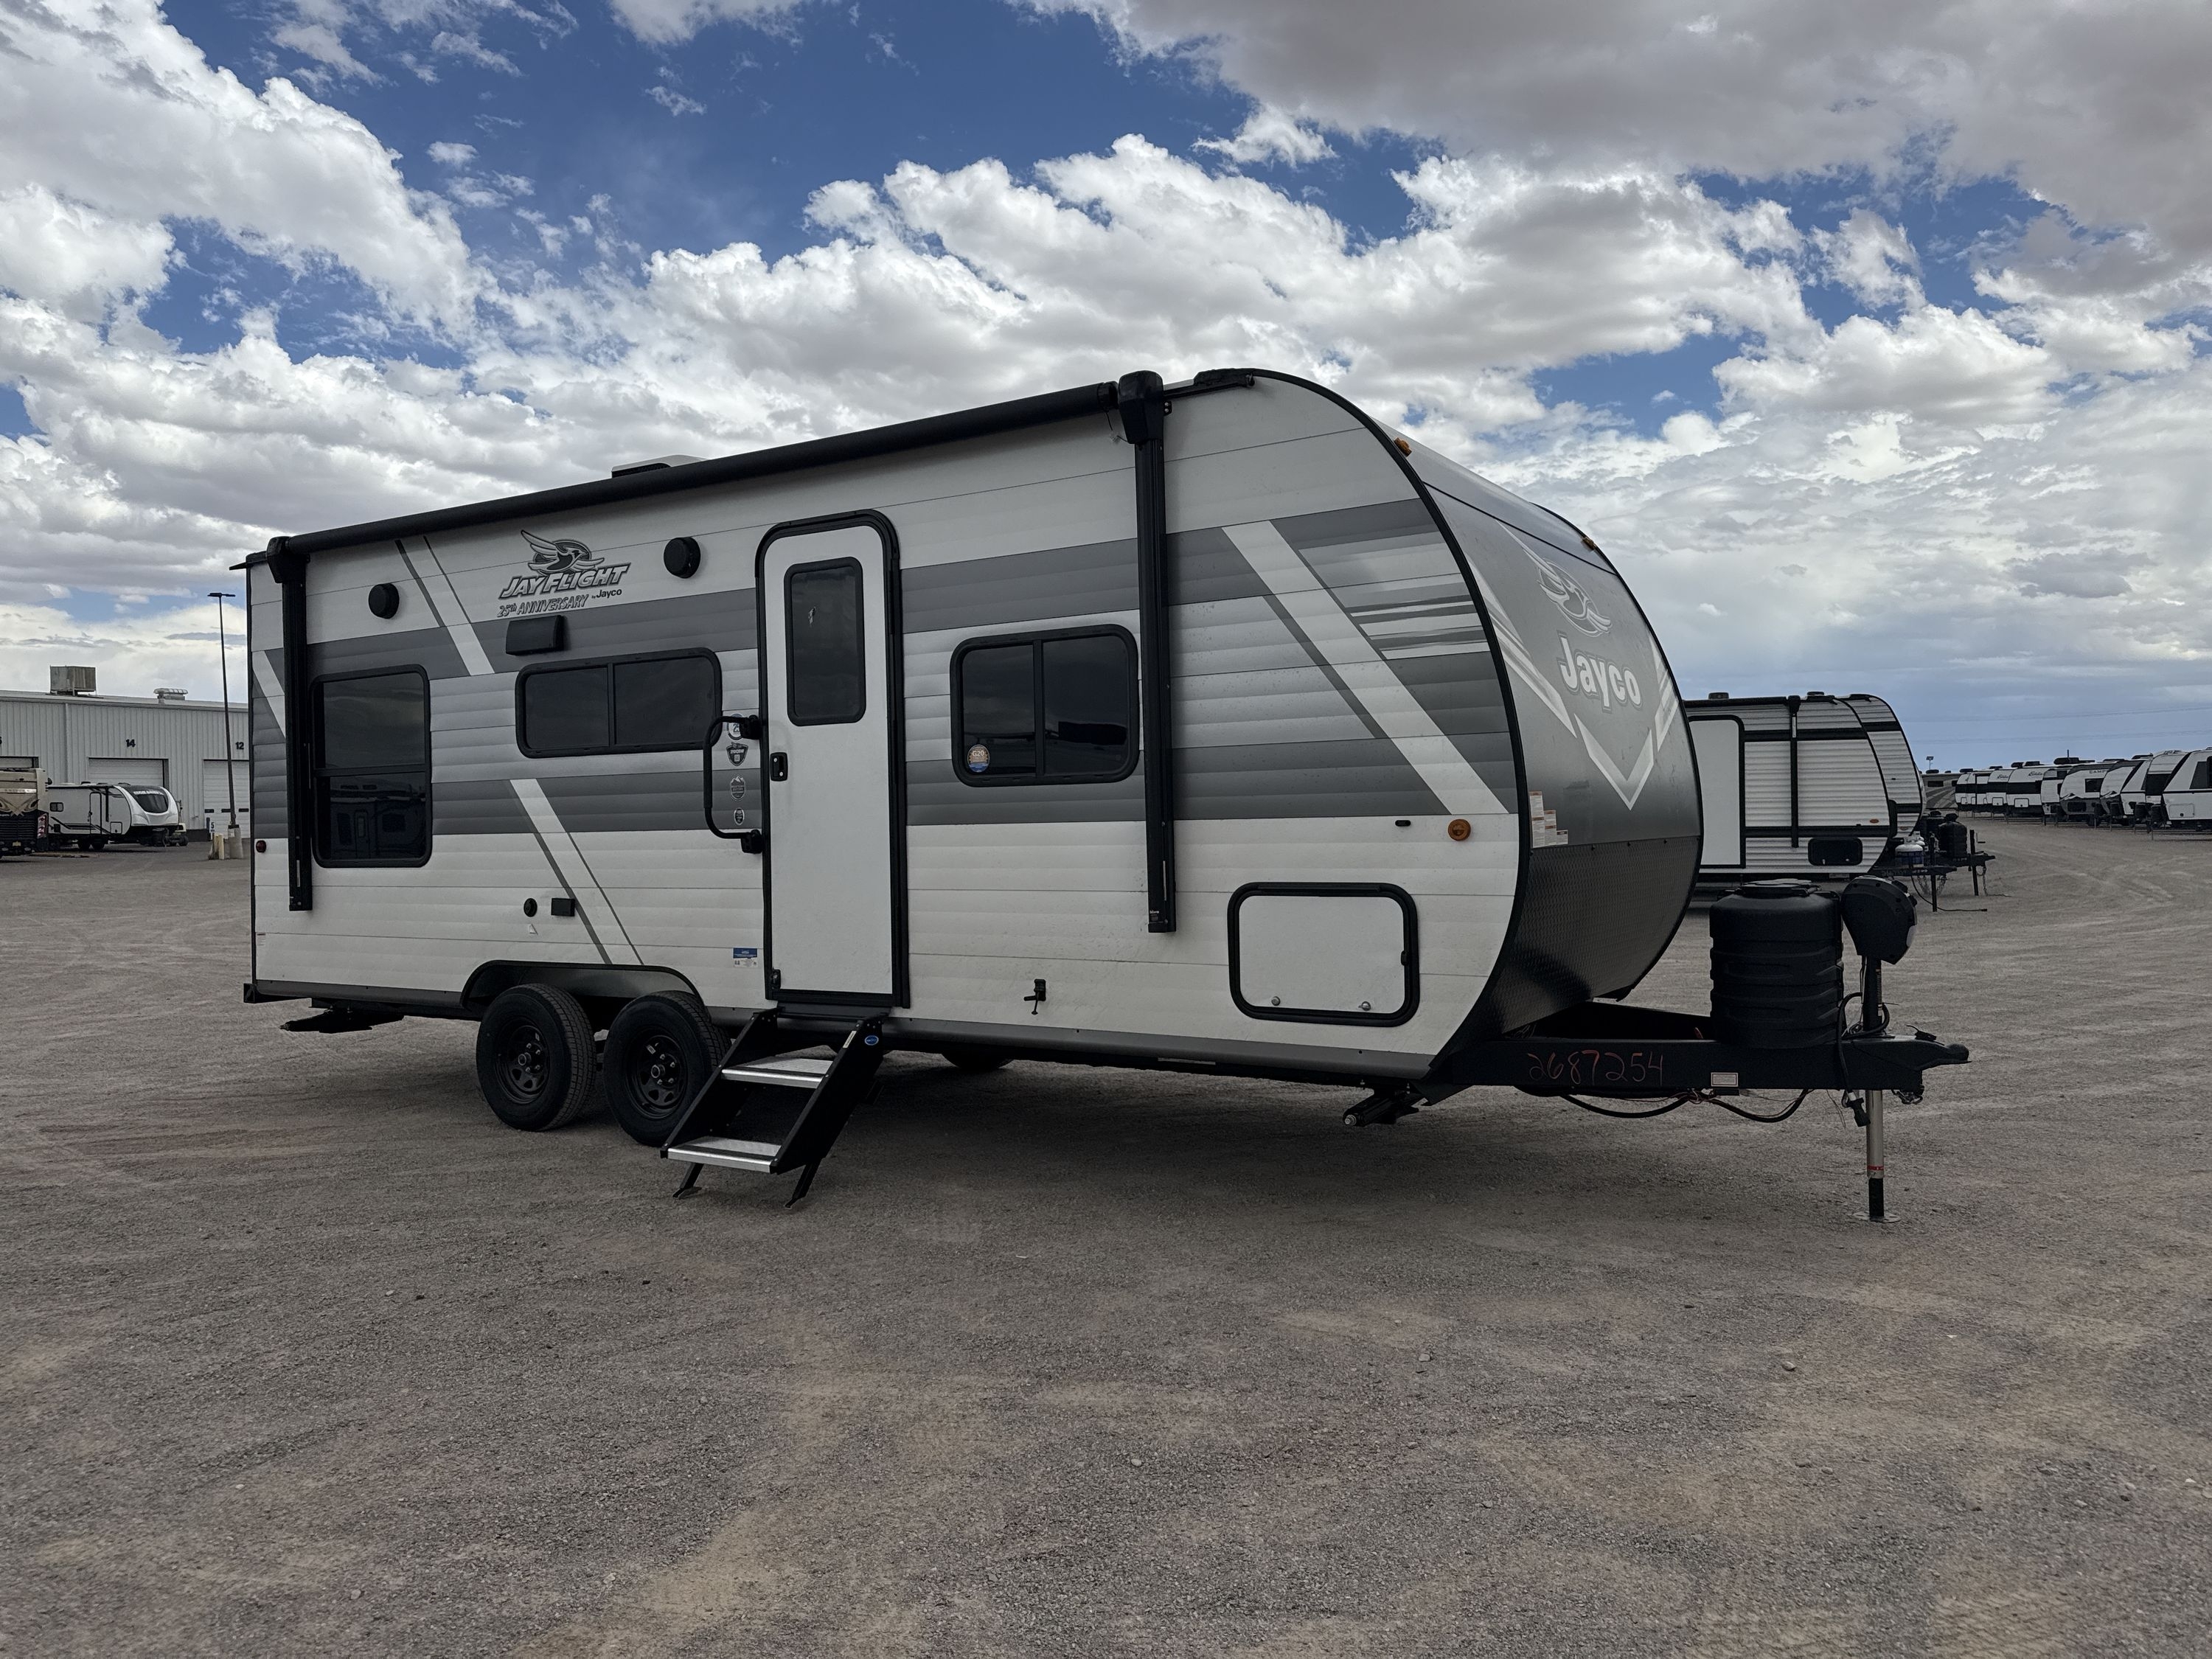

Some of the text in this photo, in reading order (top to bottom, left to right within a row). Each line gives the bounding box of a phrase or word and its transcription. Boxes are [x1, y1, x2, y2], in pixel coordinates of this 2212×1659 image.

[498, 563, 630, 599] JAY FLIGHT
[596, 588, 622, 599] Jayco
[497, 594, 589, 618] 25th ANNIVERSARY
[1558, 634, 1642, 710] Jayco
[125, 739, 136, 748] 14
[235, 741, 245, 750] 12
[1528, 1049, 1663, 1086] 2687254
